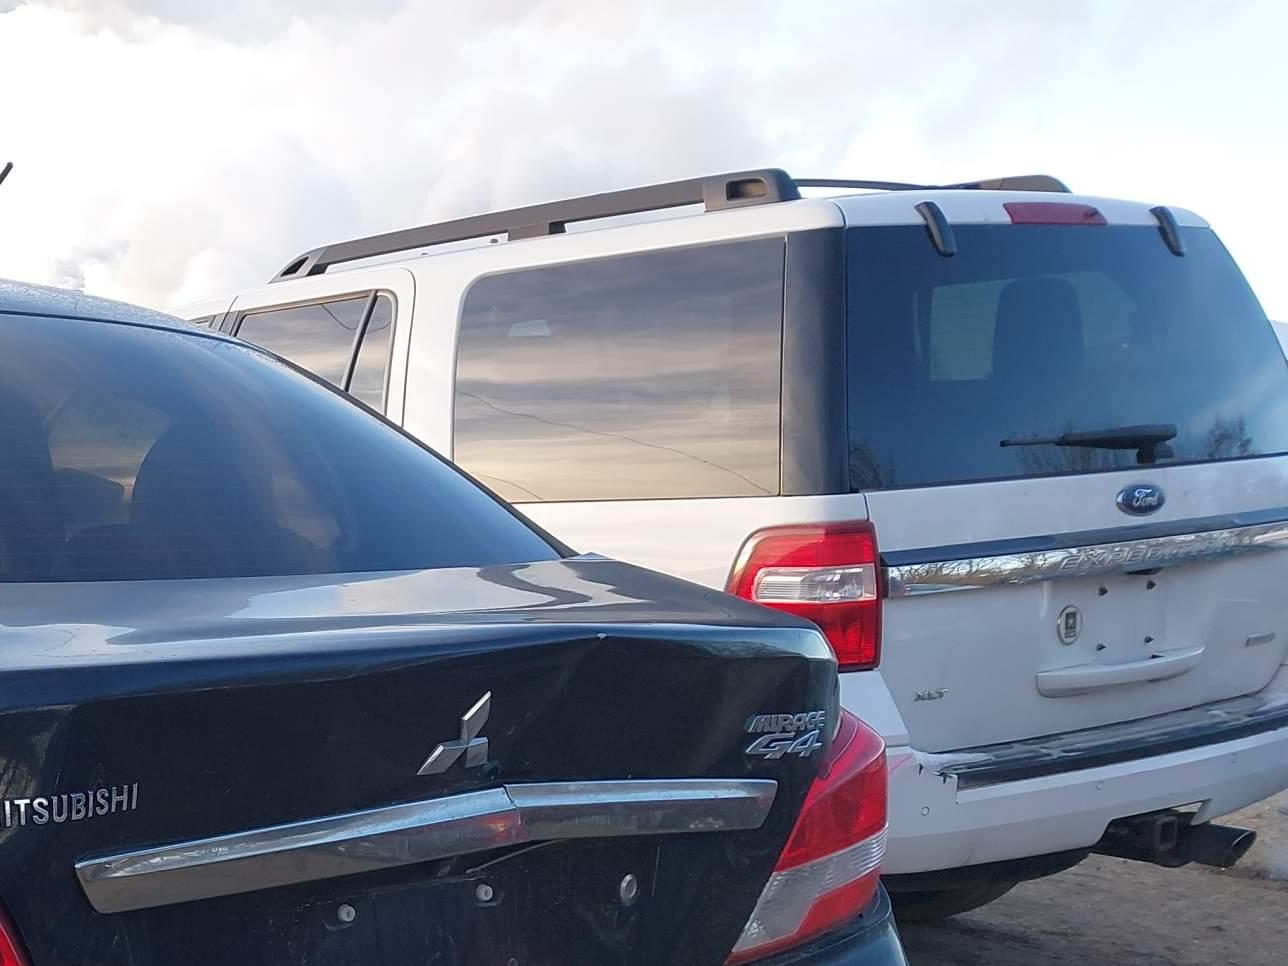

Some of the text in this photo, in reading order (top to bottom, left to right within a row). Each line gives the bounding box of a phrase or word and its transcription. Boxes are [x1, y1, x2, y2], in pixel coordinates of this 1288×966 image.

[1132, 488, 1160, 507] Ford
[748, 710, 826, 733] MIRAGE
[745, 729, 822, 759] G4
